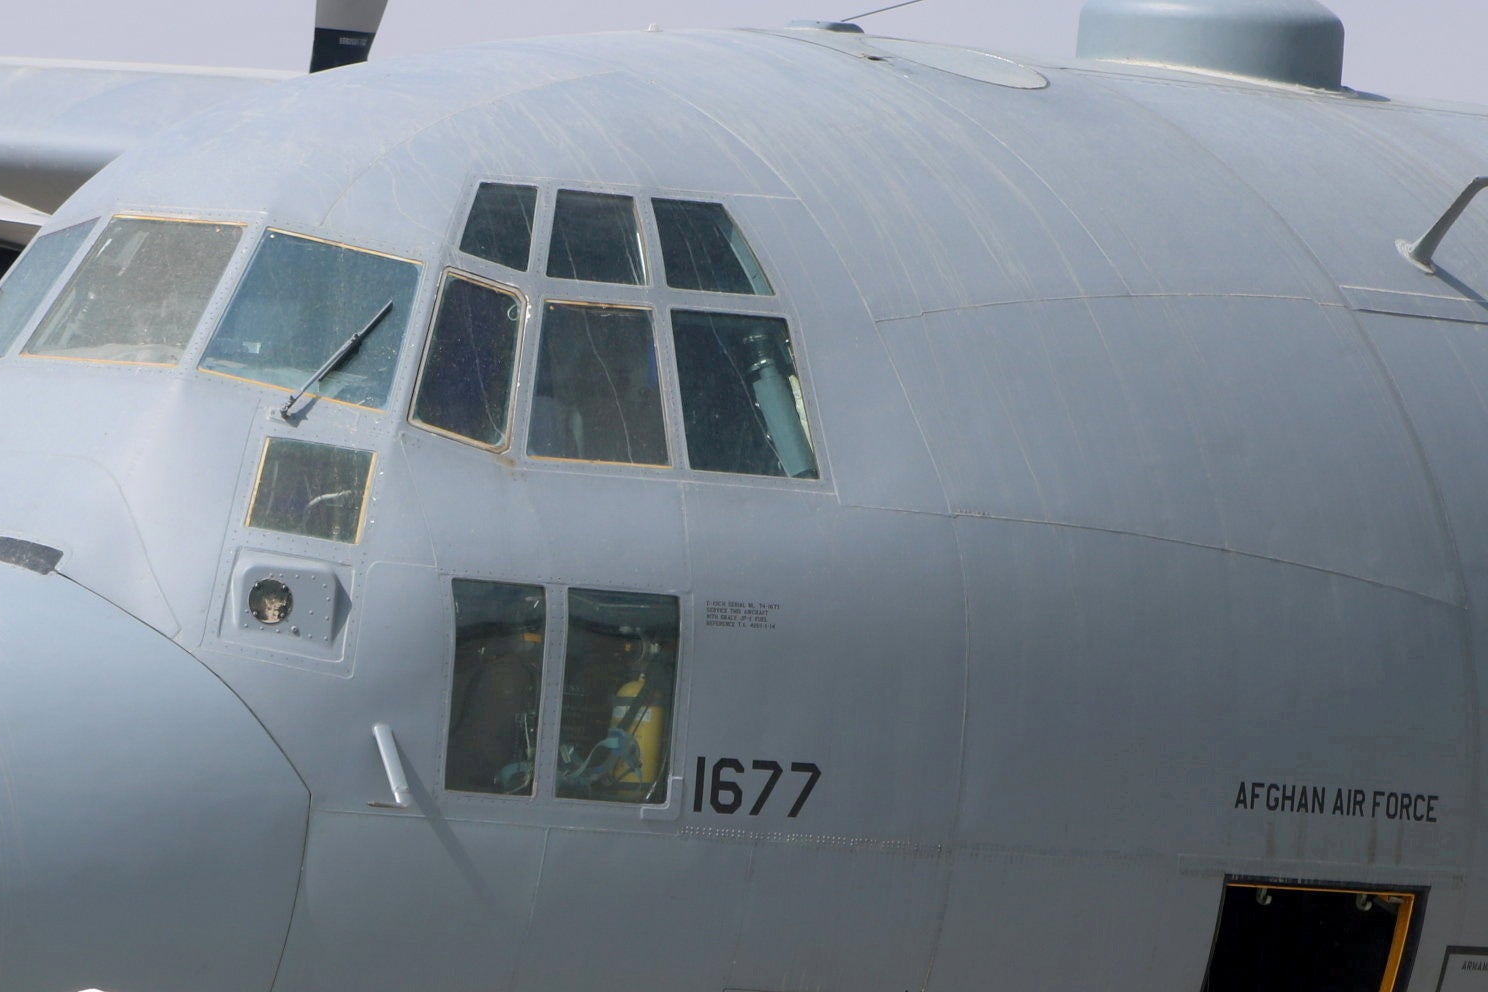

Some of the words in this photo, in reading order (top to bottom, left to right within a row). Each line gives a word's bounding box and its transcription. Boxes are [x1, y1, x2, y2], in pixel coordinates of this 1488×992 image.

[693, 756, 822, 818] 1677
[1235, 782, 1326, 815] AFGHAN
[1332, 788, 1365, 817] AIR
[1371, 791, 1440, 823] FORCE
